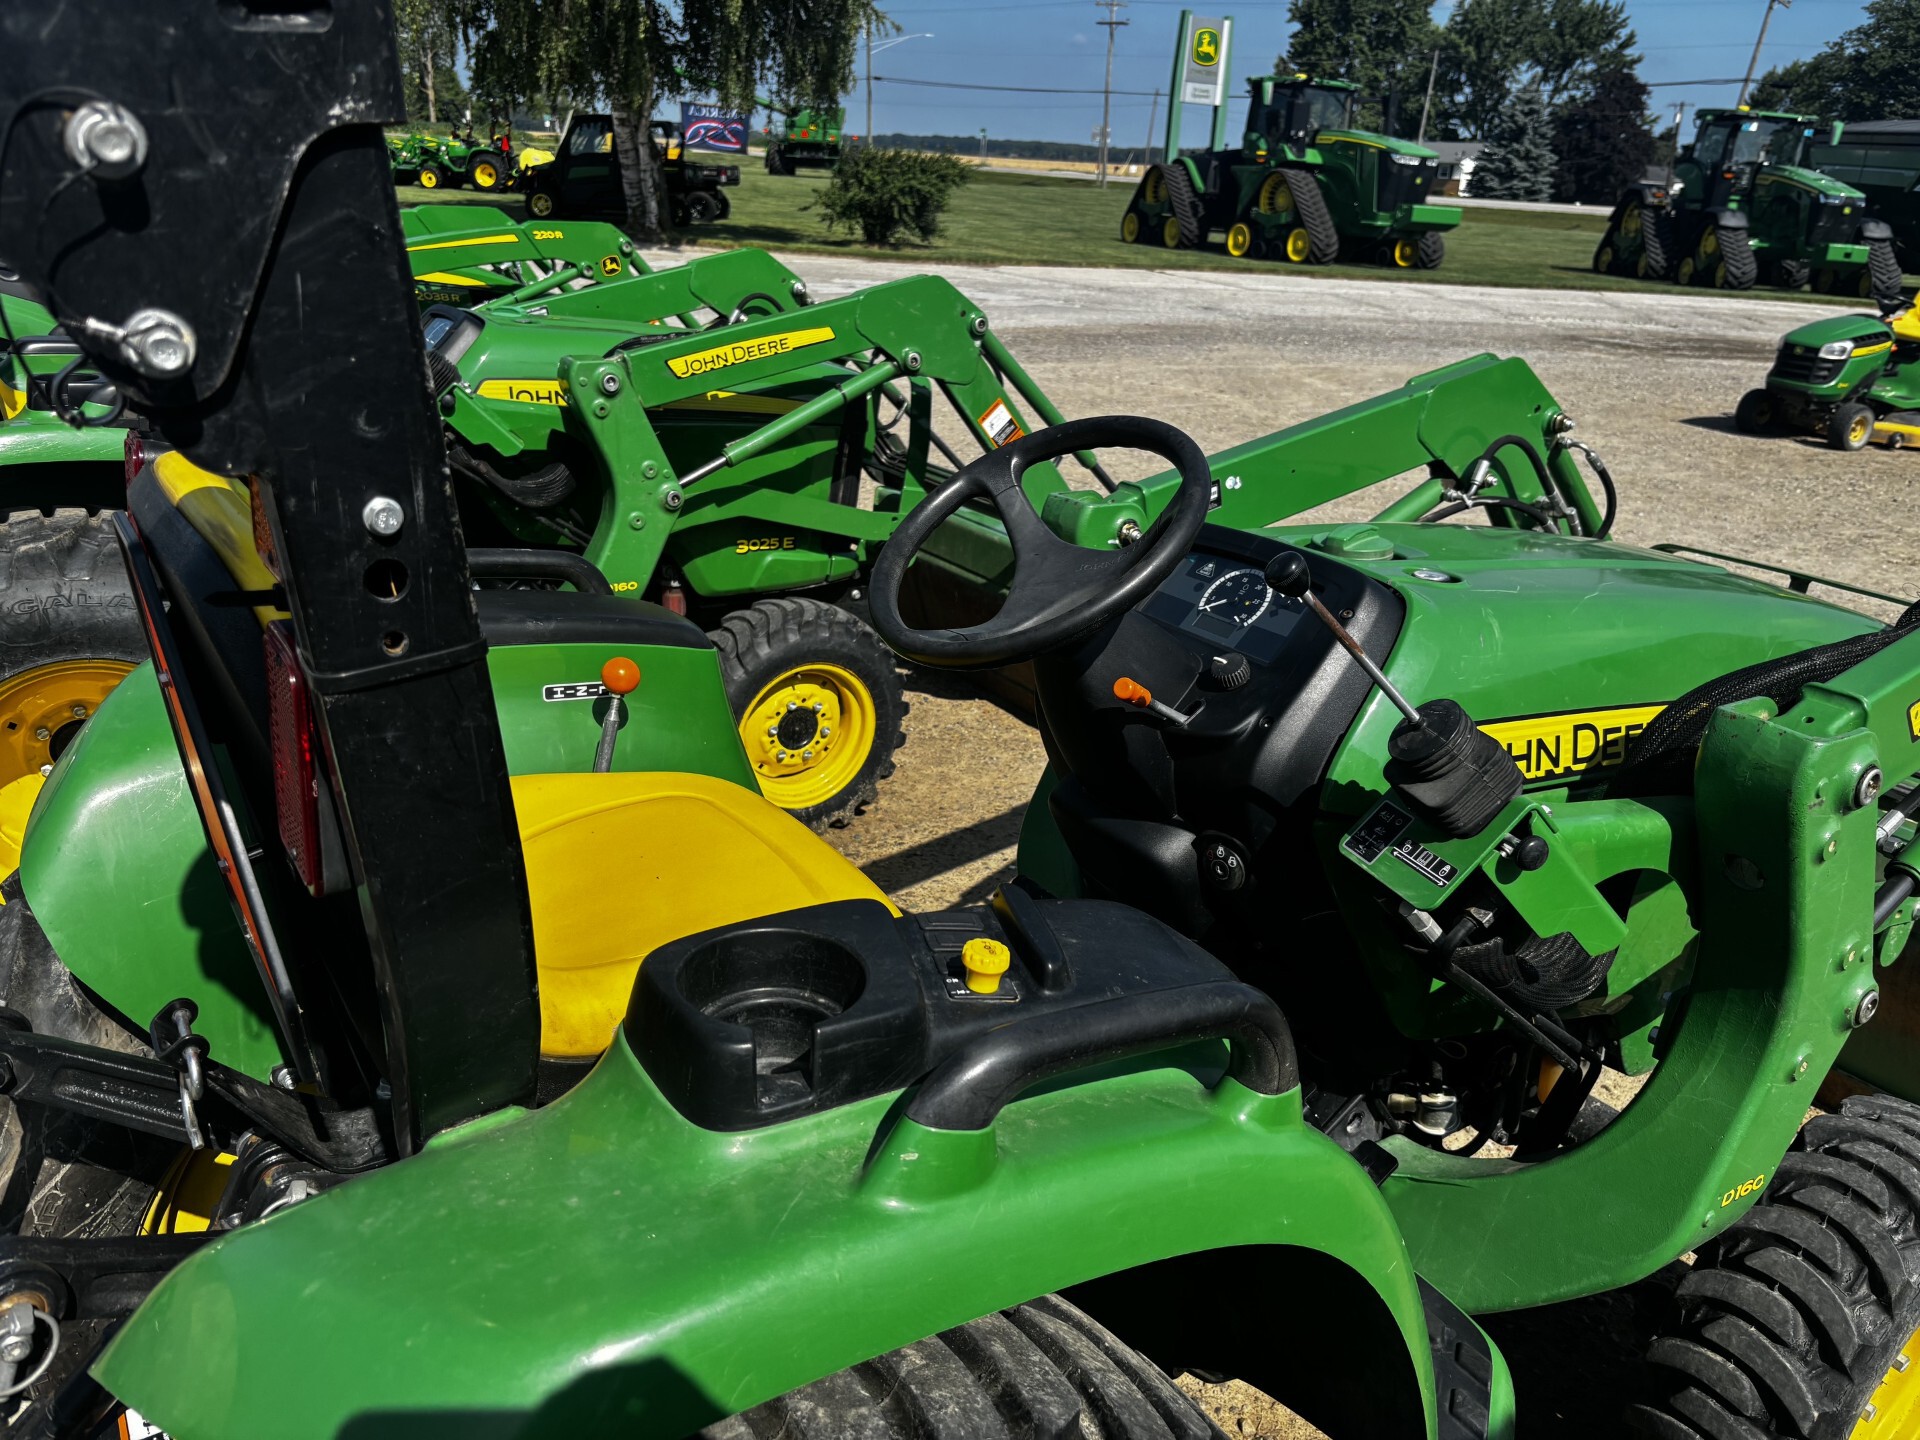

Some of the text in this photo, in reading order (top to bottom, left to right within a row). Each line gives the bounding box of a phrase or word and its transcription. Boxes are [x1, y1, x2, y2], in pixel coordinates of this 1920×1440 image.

[681, 338, 790, 375] JOHN DEERE
[609, 581, 638, 593] 160
[1507, 735, 1561, 774] HN
[1721, 1174, 1765, 1208] D160
